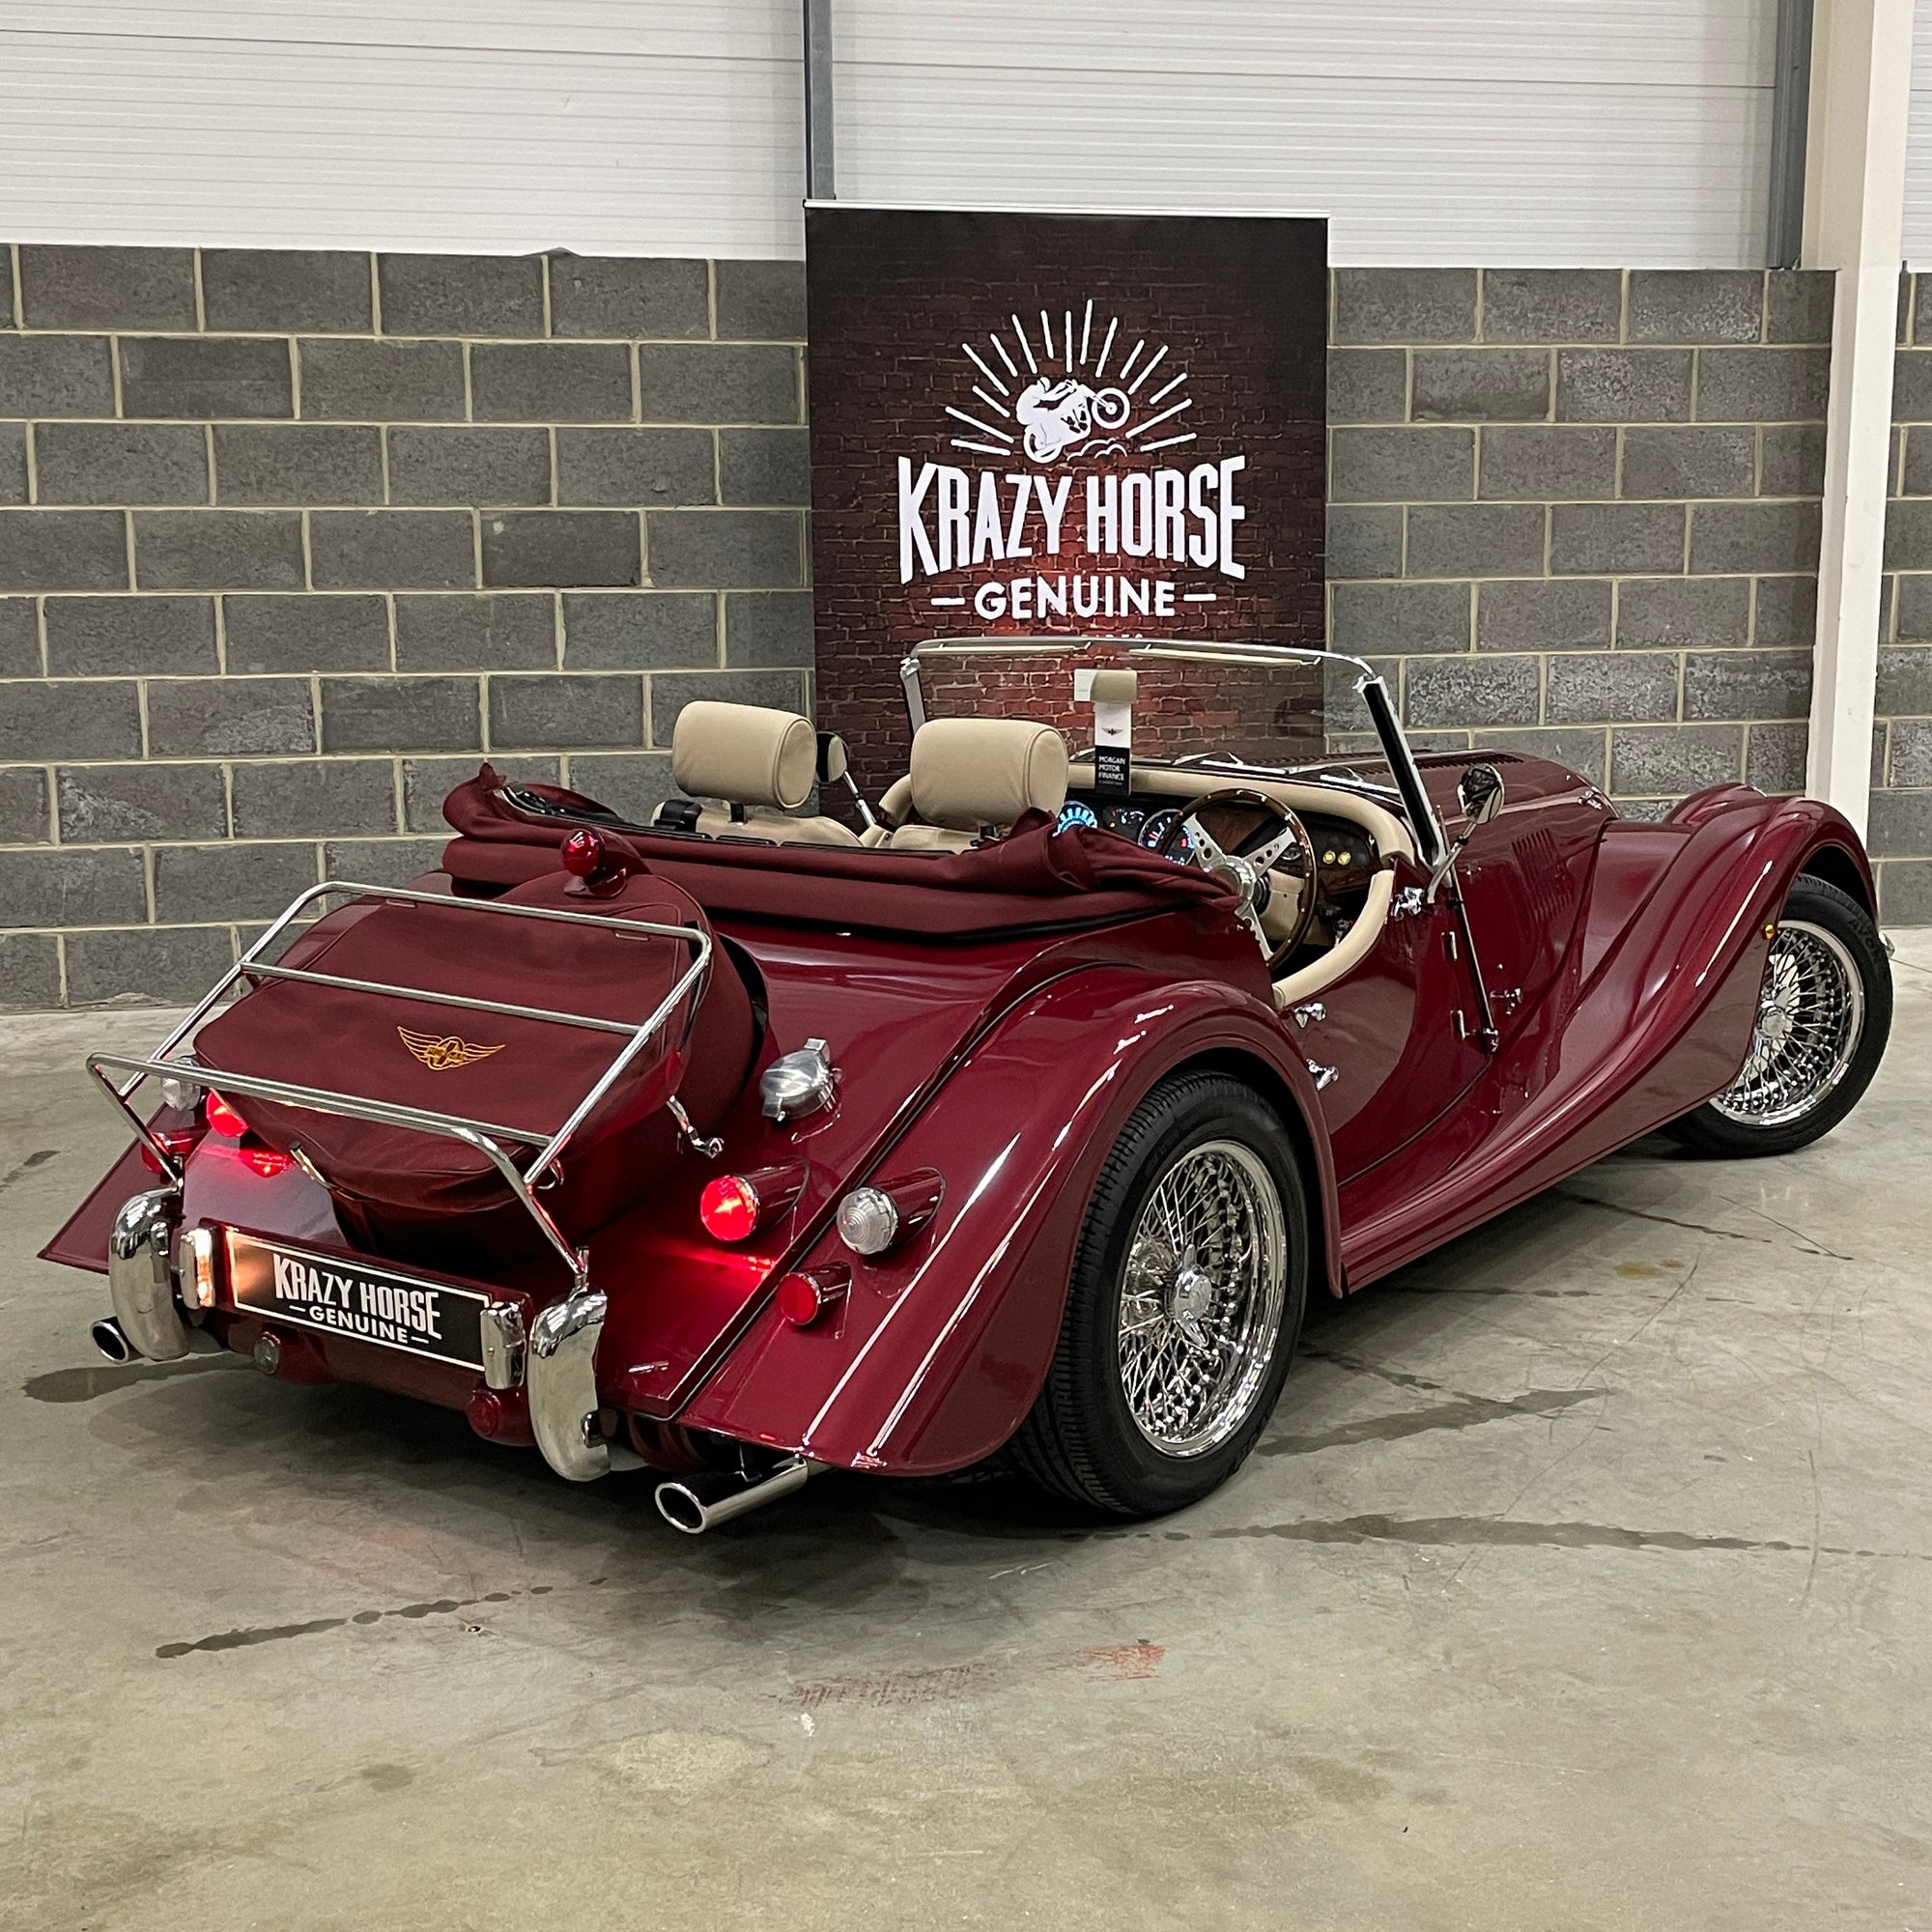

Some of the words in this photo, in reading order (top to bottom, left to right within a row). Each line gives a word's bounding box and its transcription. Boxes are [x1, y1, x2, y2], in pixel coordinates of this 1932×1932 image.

[897, 456, 1073, 584] KRAZY
[1086, 455, 1245, 581] HORSE
[974, 575, 1176, 620] GENUINE
[1098, 755, 1126, 765] MORGAN
[1098, 772, 1124, 781] FINANCE
[272, 1252, 355, 1310] KRAZY
[358, 1281, 442, 1340] HORSE
[308, 1304, 409, 1344] GENUINE
